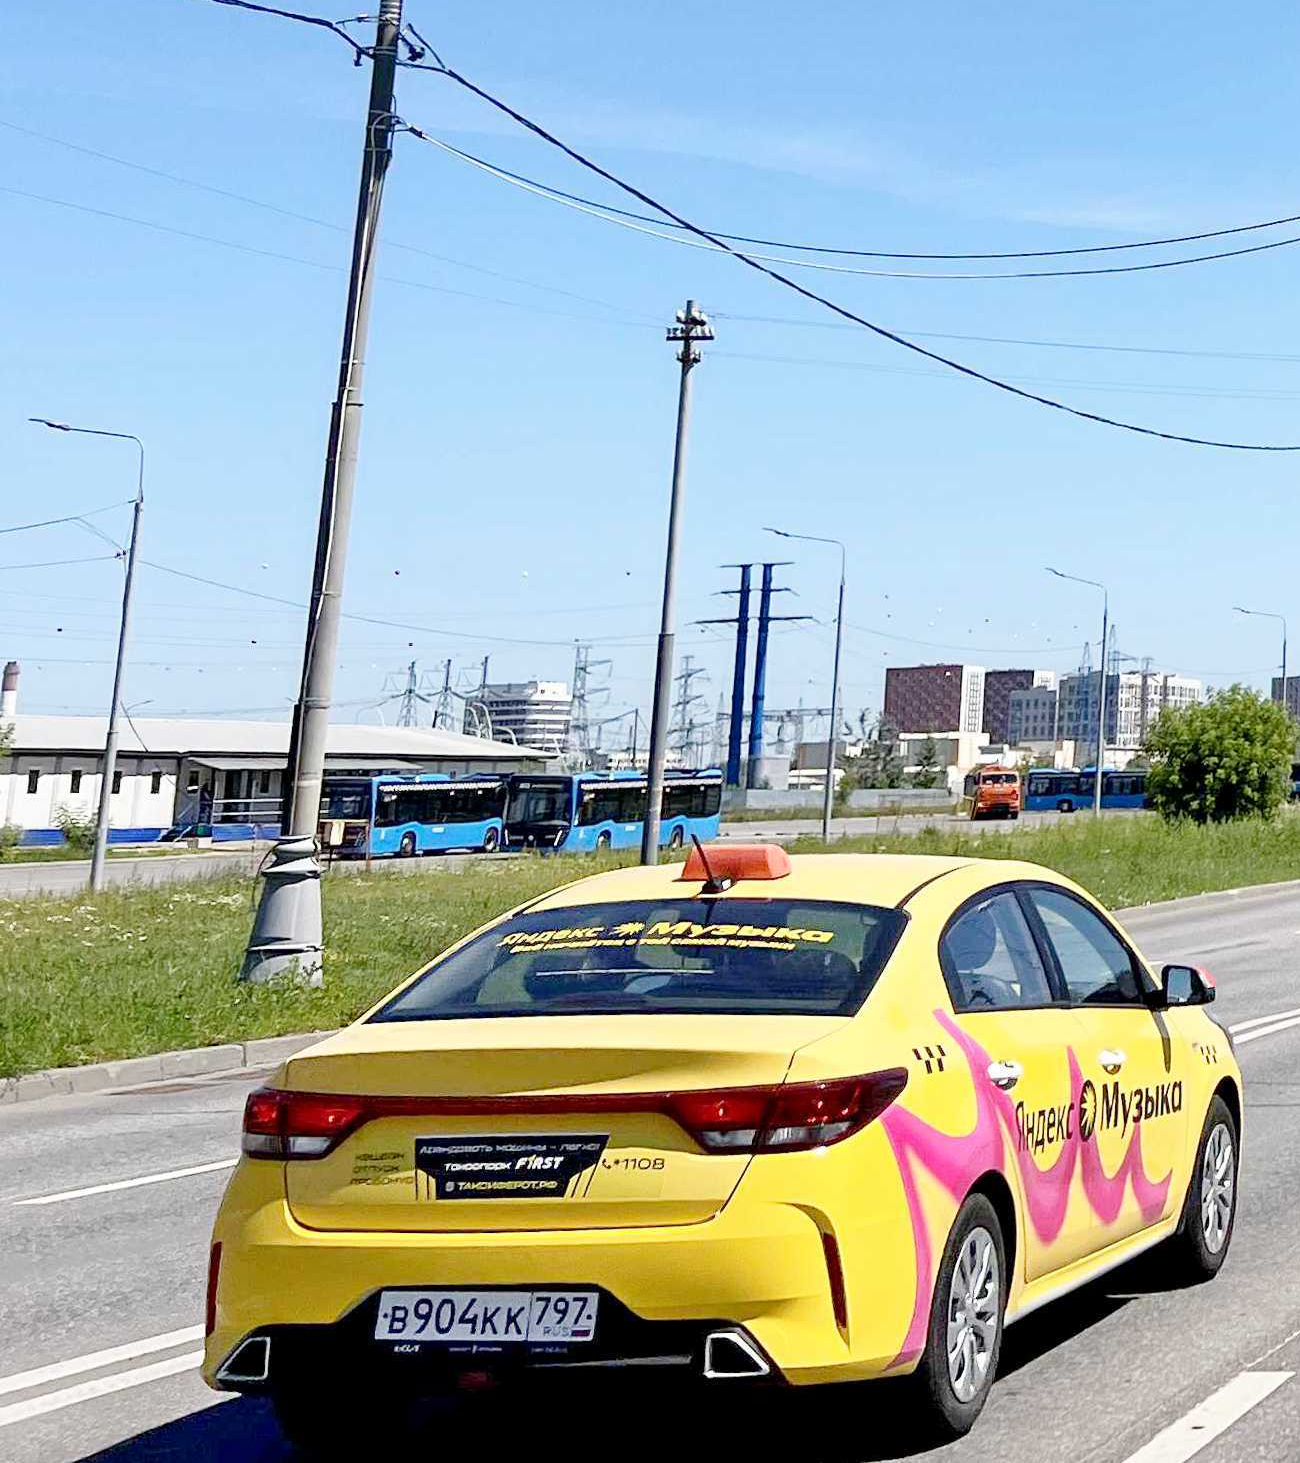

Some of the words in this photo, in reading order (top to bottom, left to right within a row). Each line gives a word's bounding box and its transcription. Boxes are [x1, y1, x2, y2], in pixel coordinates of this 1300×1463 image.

[646, 920, 835, 944] Музыка
[1015, 1101, 1075, 1156] Яндекс
[1100, 1079, 1183, 1139] Музыка
[514, 1154, 565, 1171] FIRST
[387, 1297, 526, 1336] В904КК
[535, 1296, 589, 1326] 797
[542, 1326, 569, 1338] RUS
